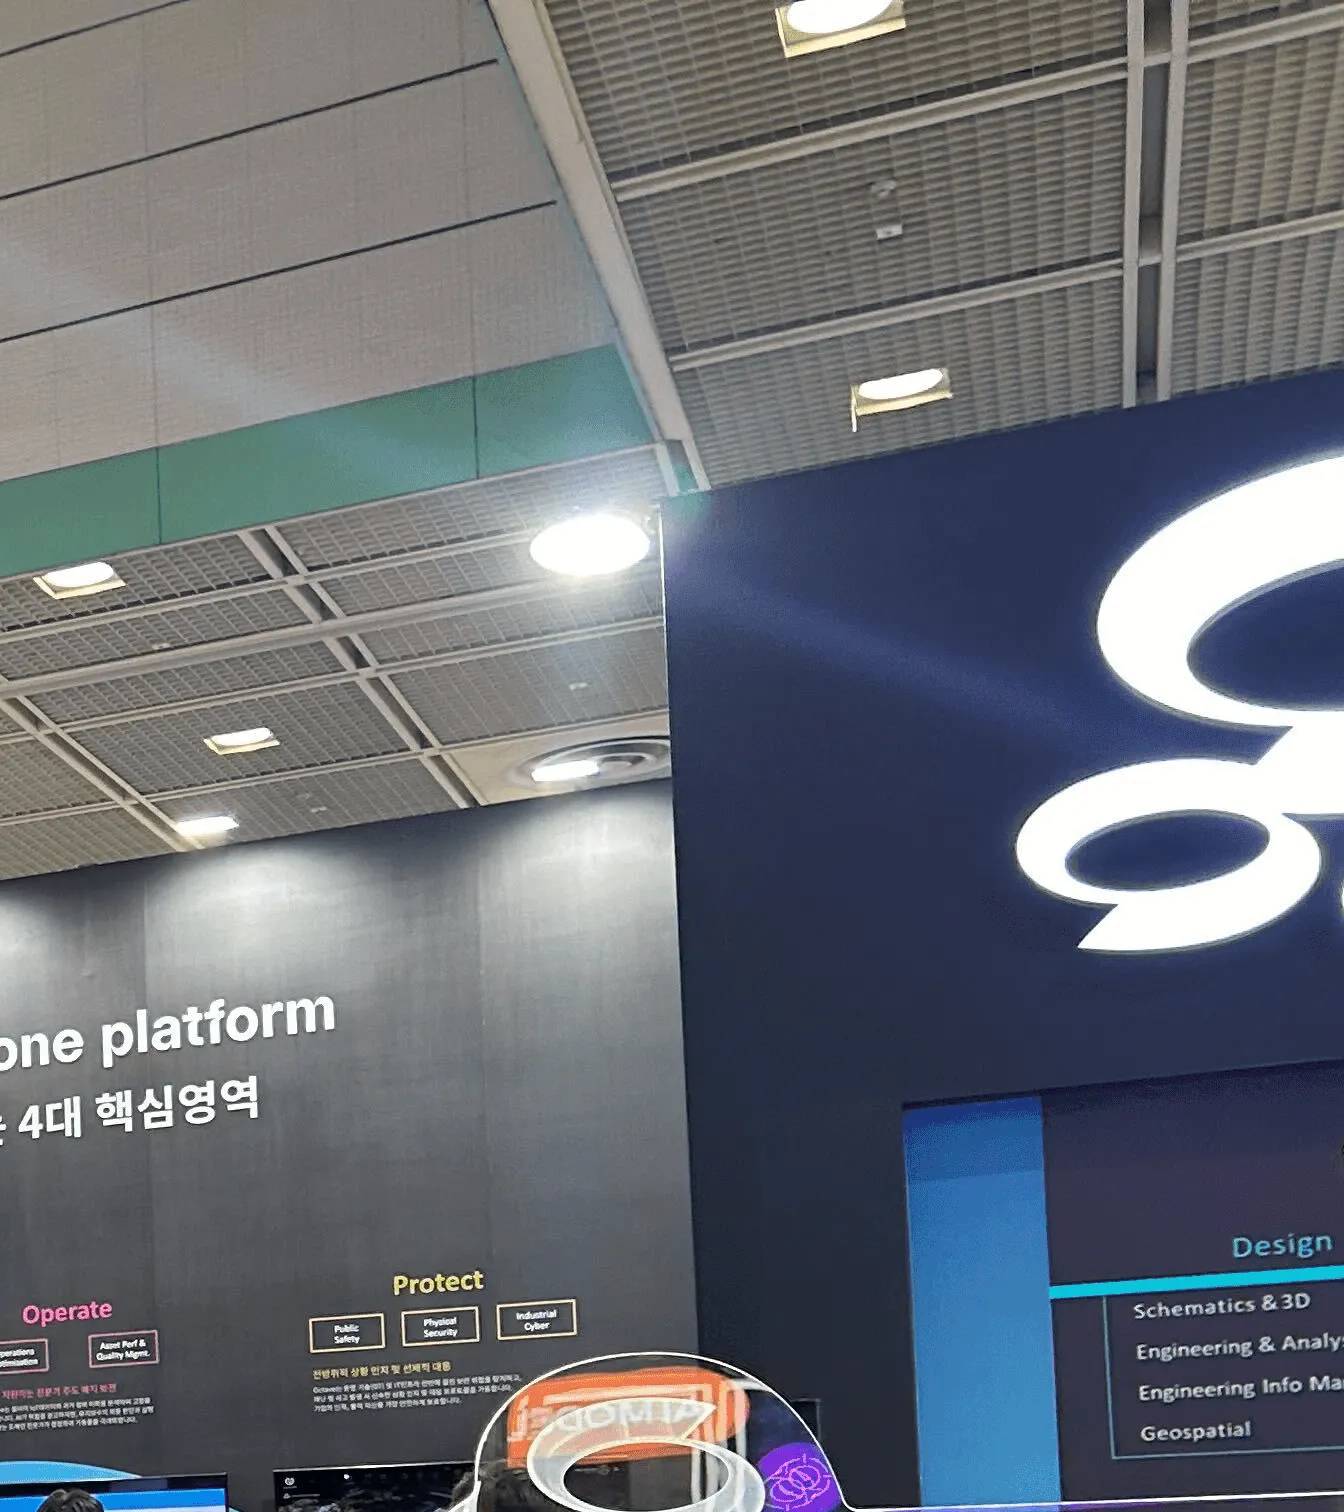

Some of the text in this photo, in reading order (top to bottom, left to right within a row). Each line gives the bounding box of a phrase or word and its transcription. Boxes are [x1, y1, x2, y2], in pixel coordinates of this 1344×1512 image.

[102, 995, 335, 1068] platform
[18, 1096, 82, 1140] 4대
[95, 1075, 259, 1133] 핵심영역
[1232, 1233, 1332, 1258] Design
[393, 1270, 484, 1296] Protect
[22, 1301, 112, 1327] Operate
[516, 1309, 557, 1321] Industrial
[1133, 1292, 1311, 1319] Schematics & 3D
[334, 1323, 360, 1333] Public
[423, 1316, 457, 1328] Physical
[423, 1327, 458, 1339] Security
[524, 1320, 549, 1332] Cyber
[122, 1339, 138, 1349] Perf
[334, 1334, 360, 1345] Safety
[1136, 1340, 1253, 1362] Engineering
[1259, 1336, 1276, 1352] &
[1139, 1381, 1255, 1403] Engineering
[1263, 1376, 1303, 1394] Info
[1140, 1421, 1252, 1442] Geospatial
